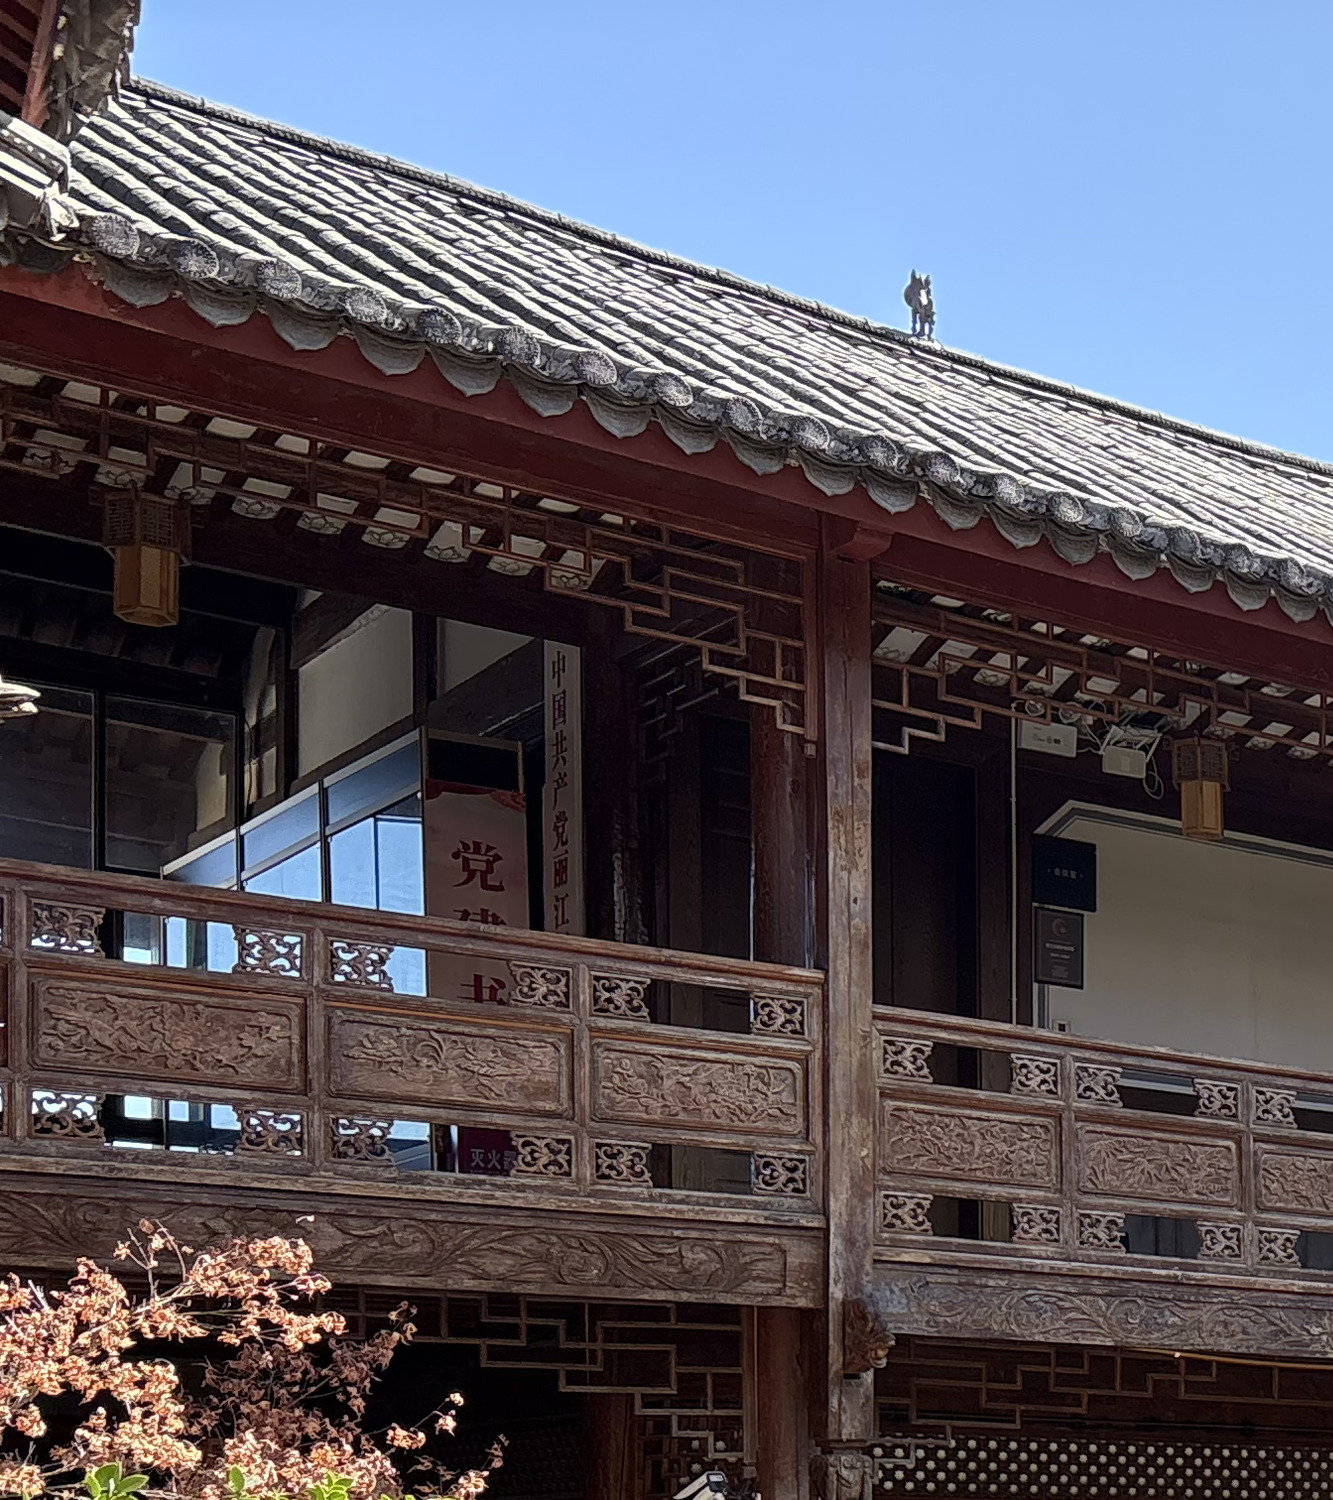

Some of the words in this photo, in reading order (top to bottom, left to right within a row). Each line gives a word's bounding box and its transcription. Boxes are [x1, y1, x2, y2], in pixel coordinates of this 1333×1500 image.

[551, 650, 569, 937] 中国共产党丽江
